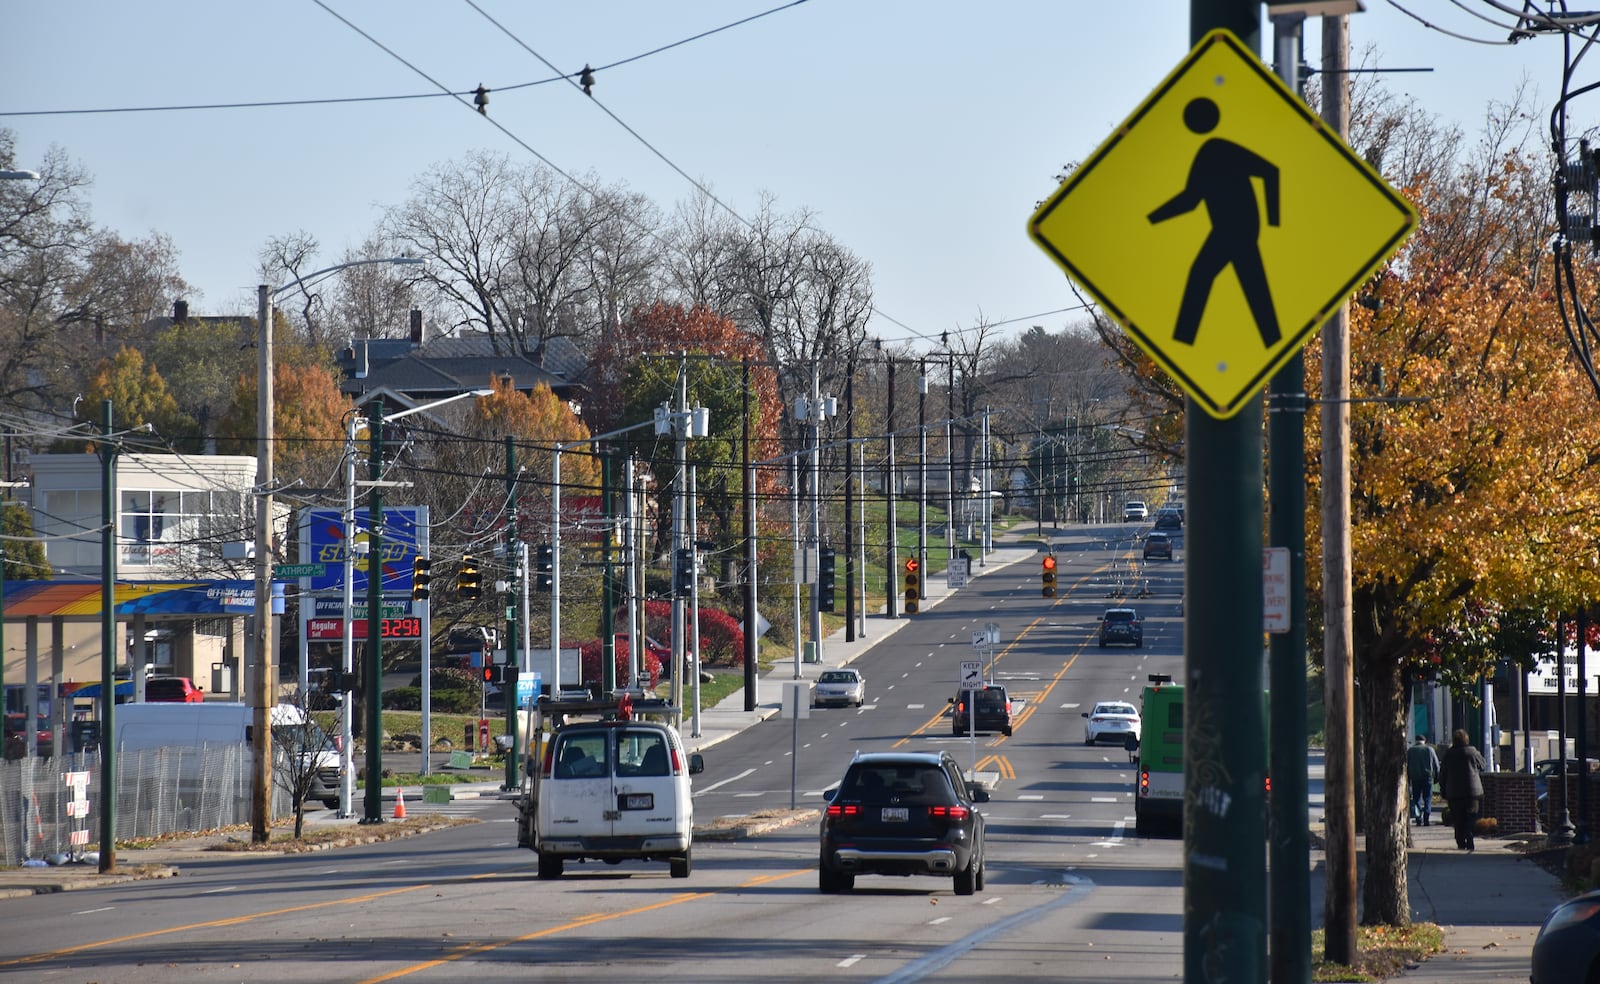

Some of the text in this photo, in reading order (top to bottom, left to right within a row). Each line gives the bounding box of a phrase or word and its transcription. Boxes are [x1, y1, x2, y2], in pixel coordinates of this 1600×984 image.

[275, 566, 313, 577] LATHROP
[316, 601, 344, 610] OFFICIA
[354, 608, 388, 619] Wyog
[311, 621, 337, 631] Regular
[519, 680, 537, 690] ZYN
[962, 681, 981, 689] RIGHT
